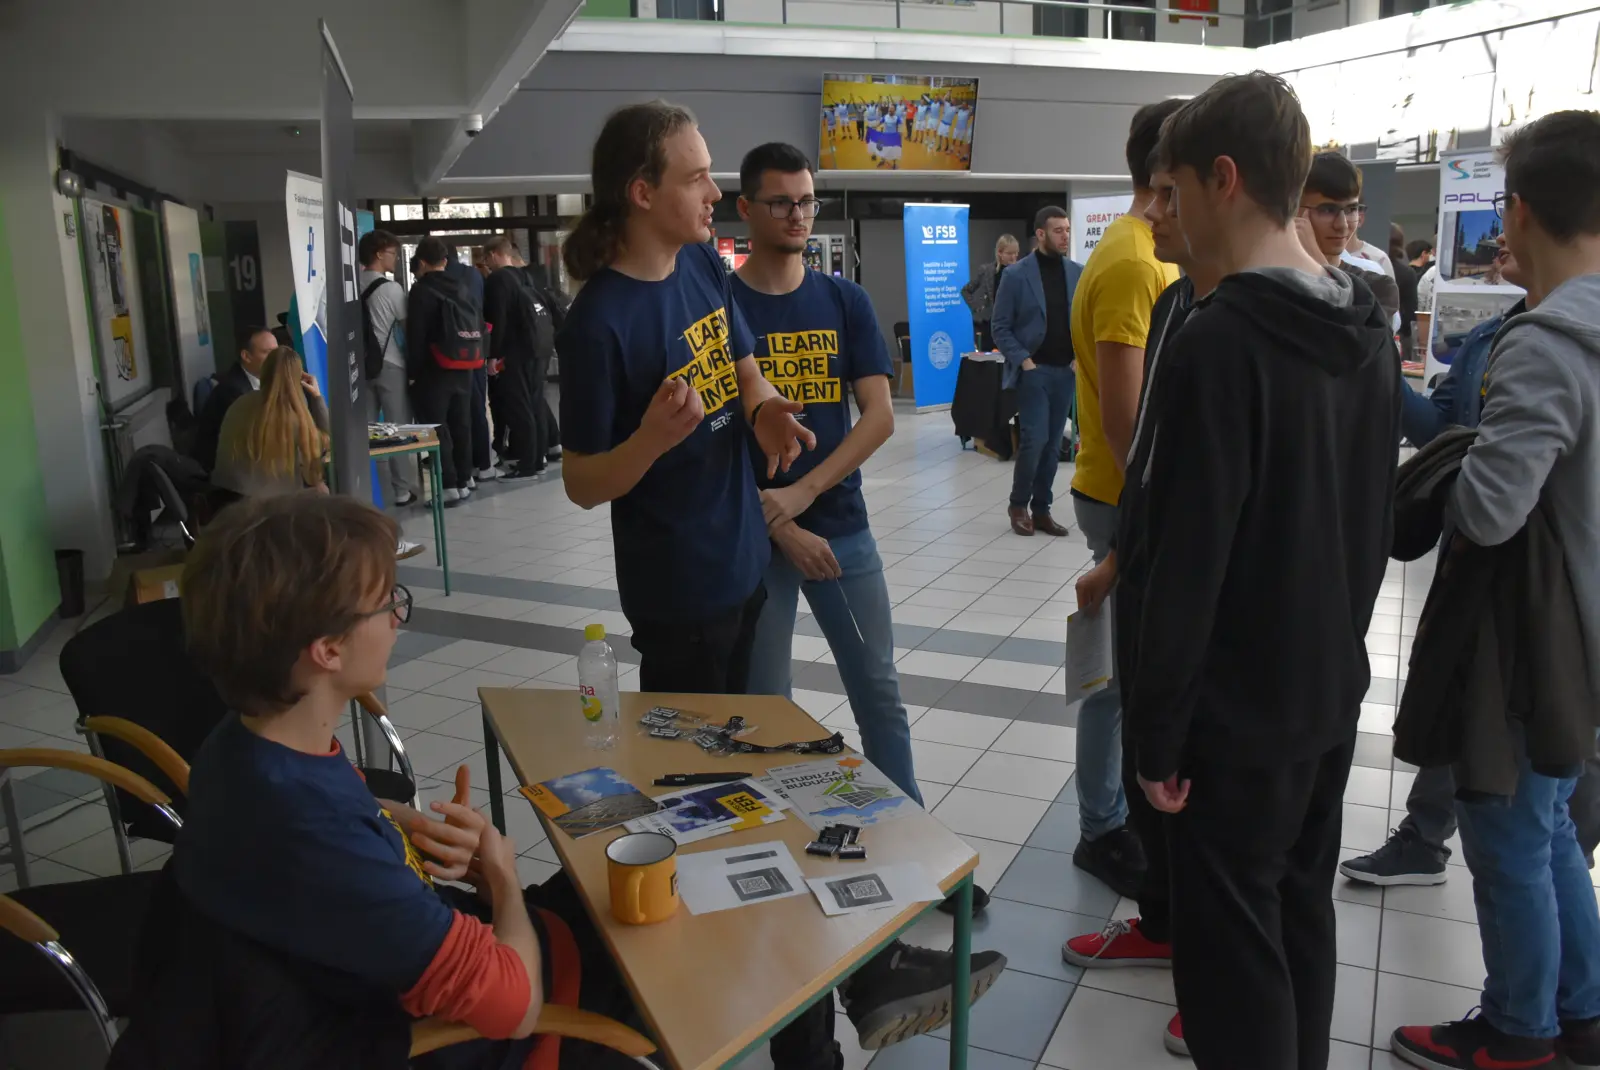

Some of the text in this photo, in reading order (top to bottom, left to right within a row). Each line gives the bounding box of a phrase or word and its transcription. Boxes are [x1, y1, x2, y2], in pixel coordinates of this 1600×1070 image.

[1086, 212, 1125, 223] GREAT ID
[935, 225, 957, 239] FSB
[1086, 227, 1101, 236] ARE
[229, 254, 257, 291] 19
[771, 334, 836, 354] LEARN
[756, 357, 825, 378] PLORE
[774, 381, 838, 401] NVENT
[580, 684, 596, 696] na
[780, 772, 823, 785] STUDIJ
